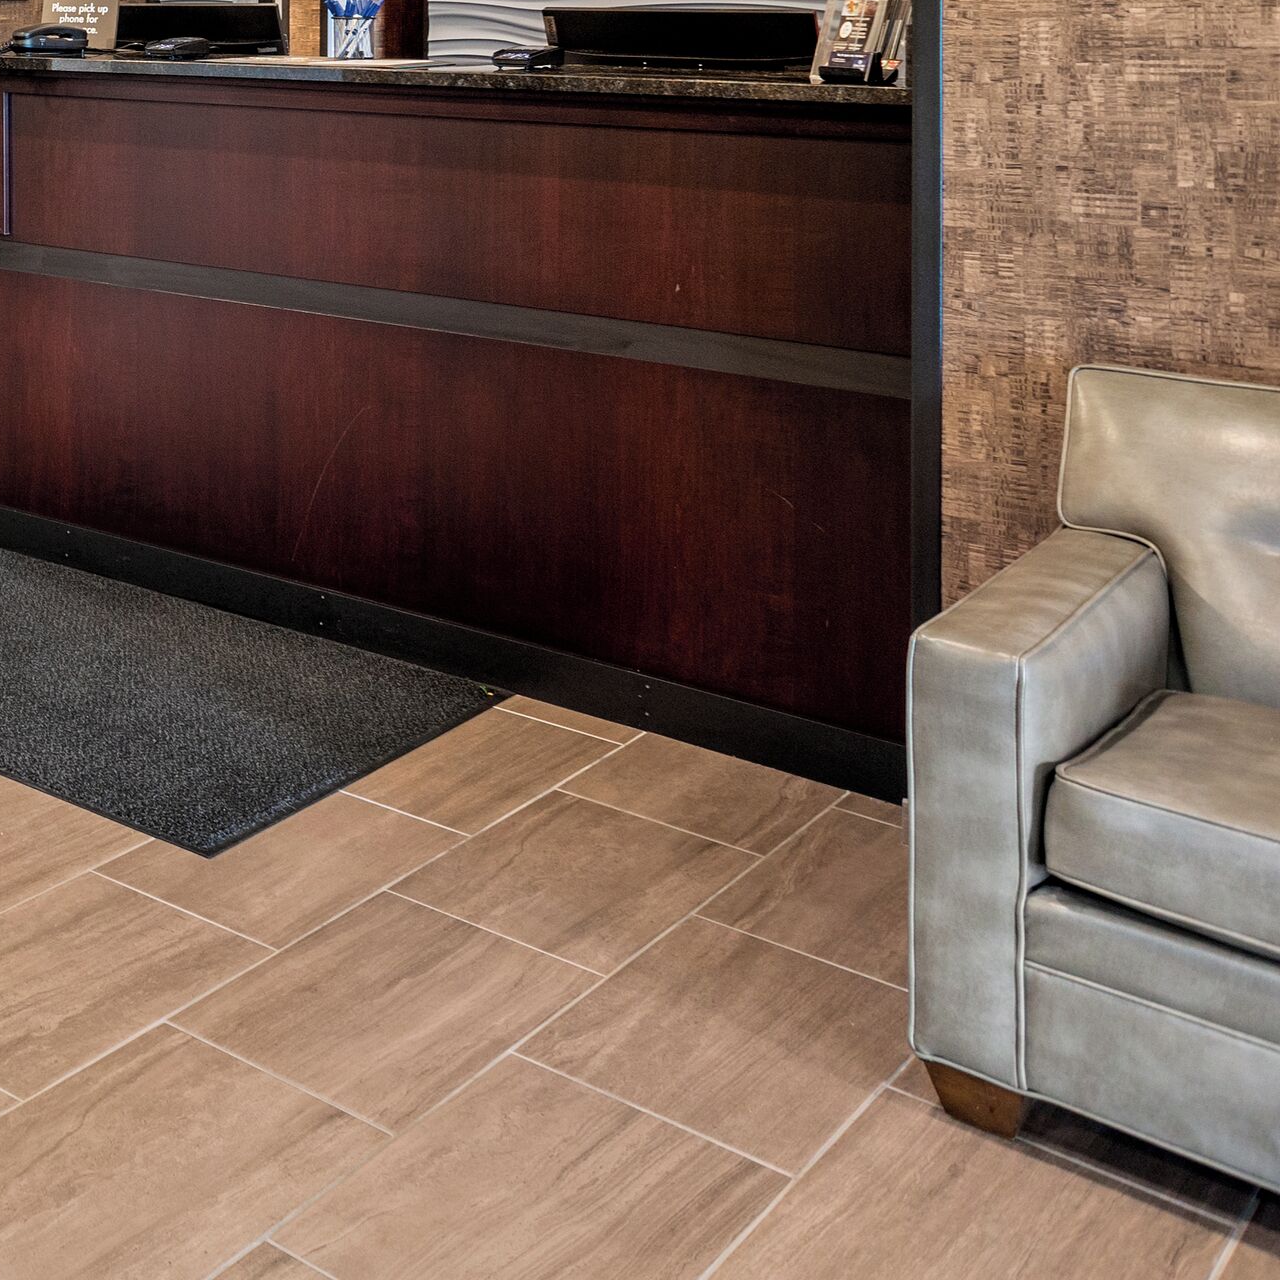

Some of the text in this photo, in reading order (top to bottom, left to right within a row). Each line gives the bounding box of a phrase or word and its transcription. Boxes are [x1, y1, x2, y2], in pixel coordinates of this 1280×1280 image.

[51, 2, 109, 16] Please pick up
[59, 13, 99, 25] phone for
